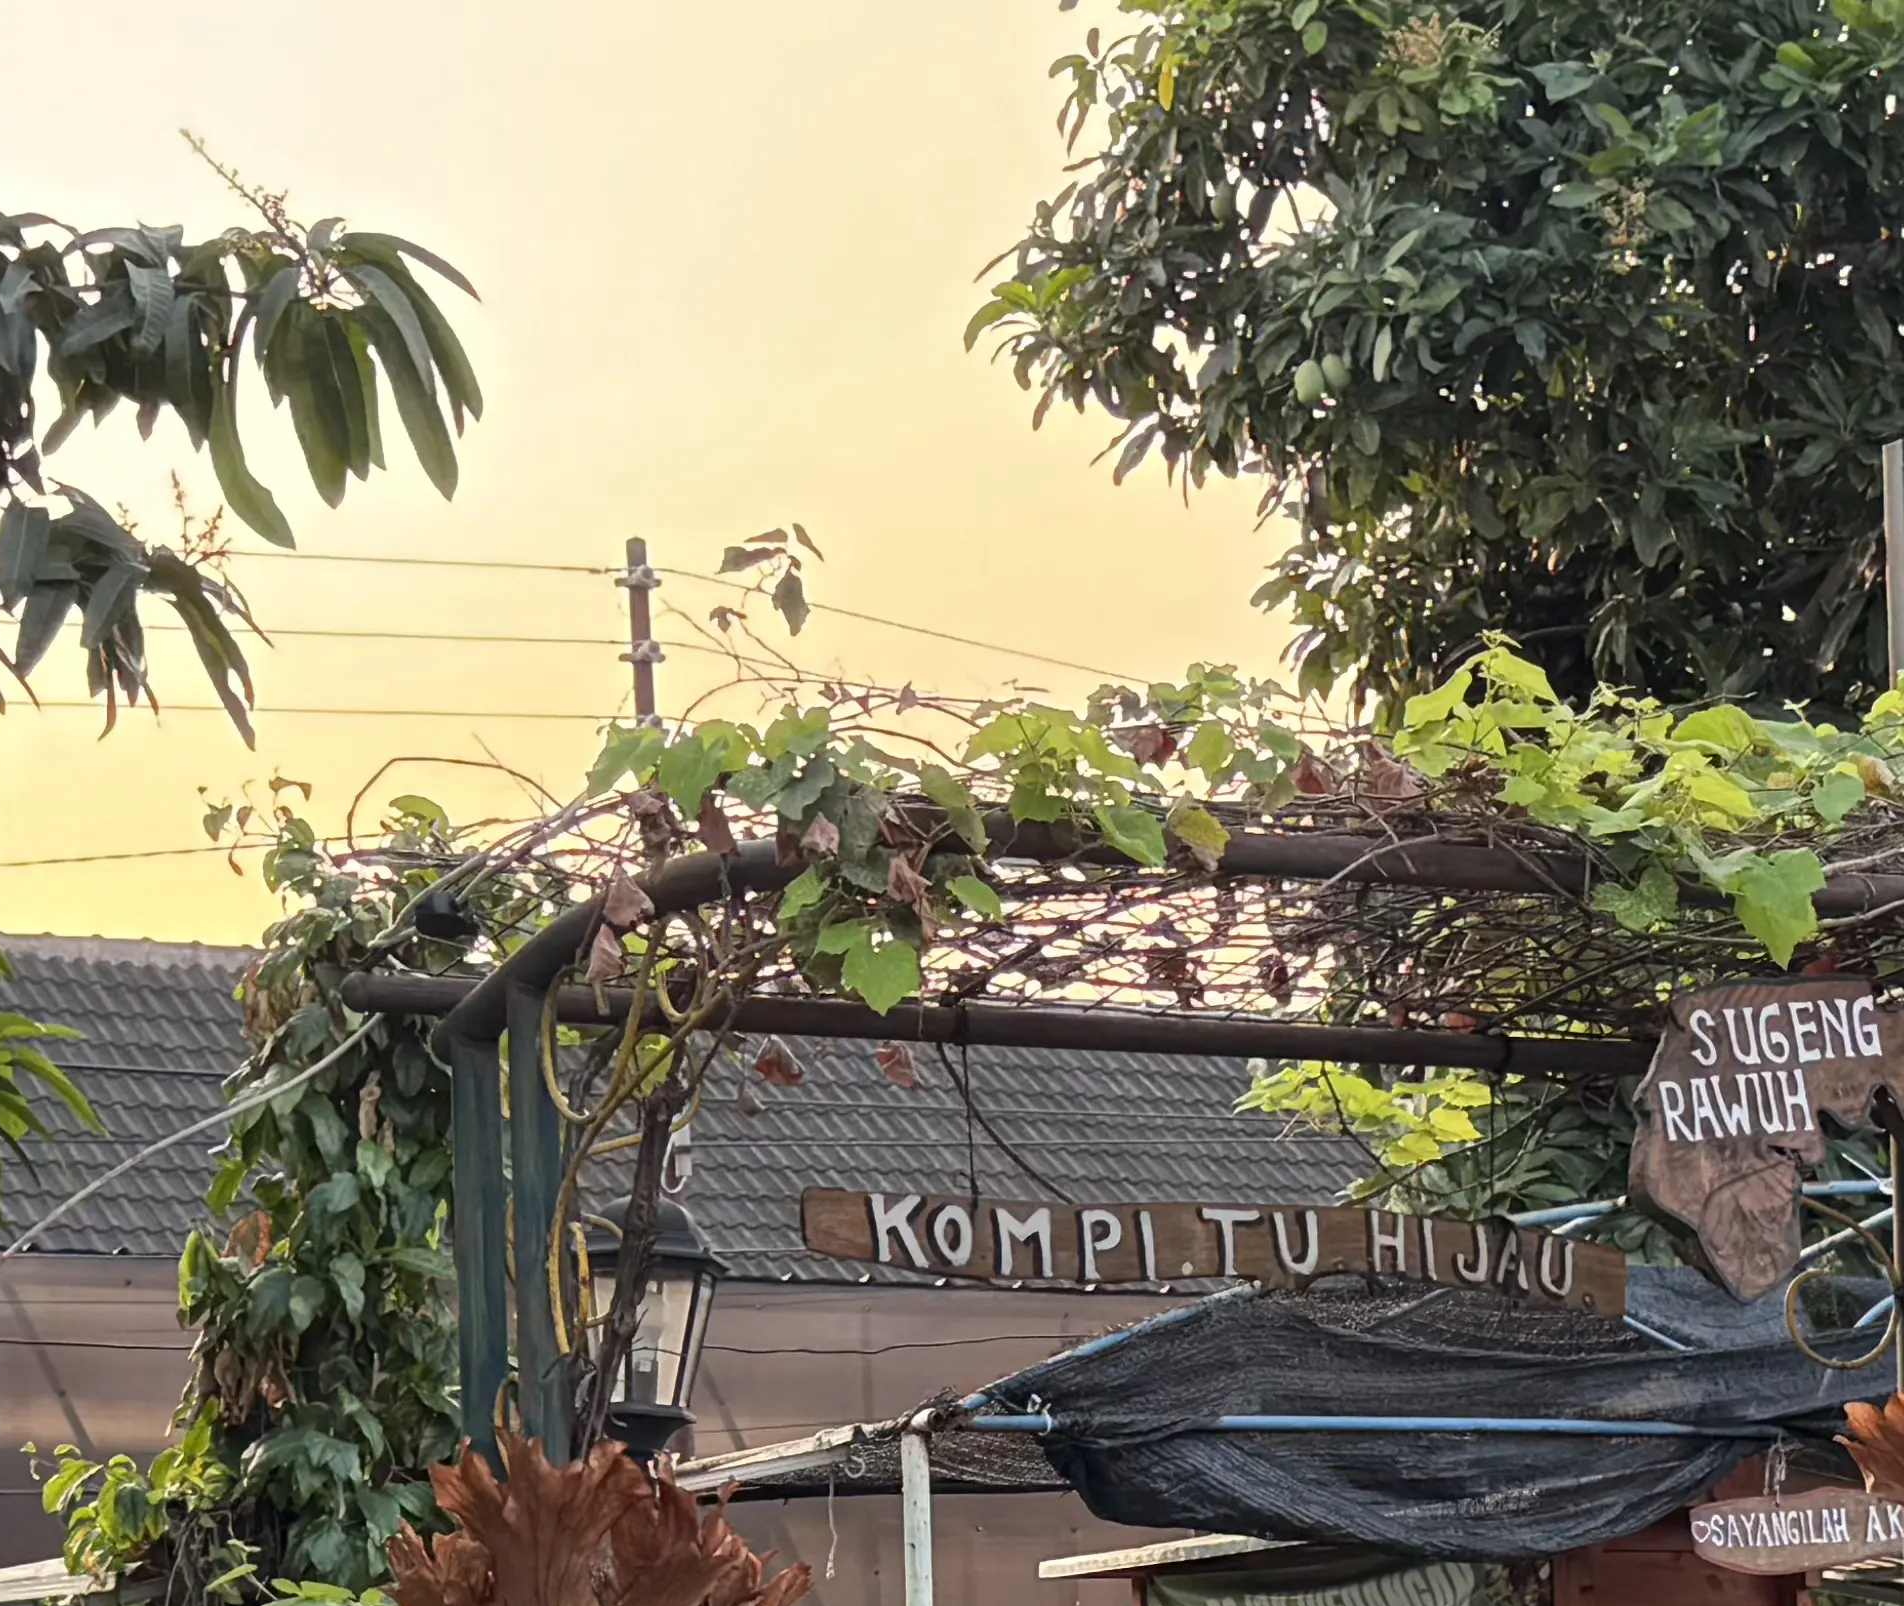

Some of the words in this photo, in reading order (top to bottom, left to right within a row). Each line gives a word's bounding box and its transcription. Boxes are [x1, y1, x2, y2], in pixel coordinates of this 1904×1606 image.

[1688, 994, 1883, 1067] SUGENG
[1658, 1068, 1816, 1143] RAWUH
[1710, 1507, 1850, 1548] SAYANGILAH
[1866, 1503, 1904, 1543] AK
